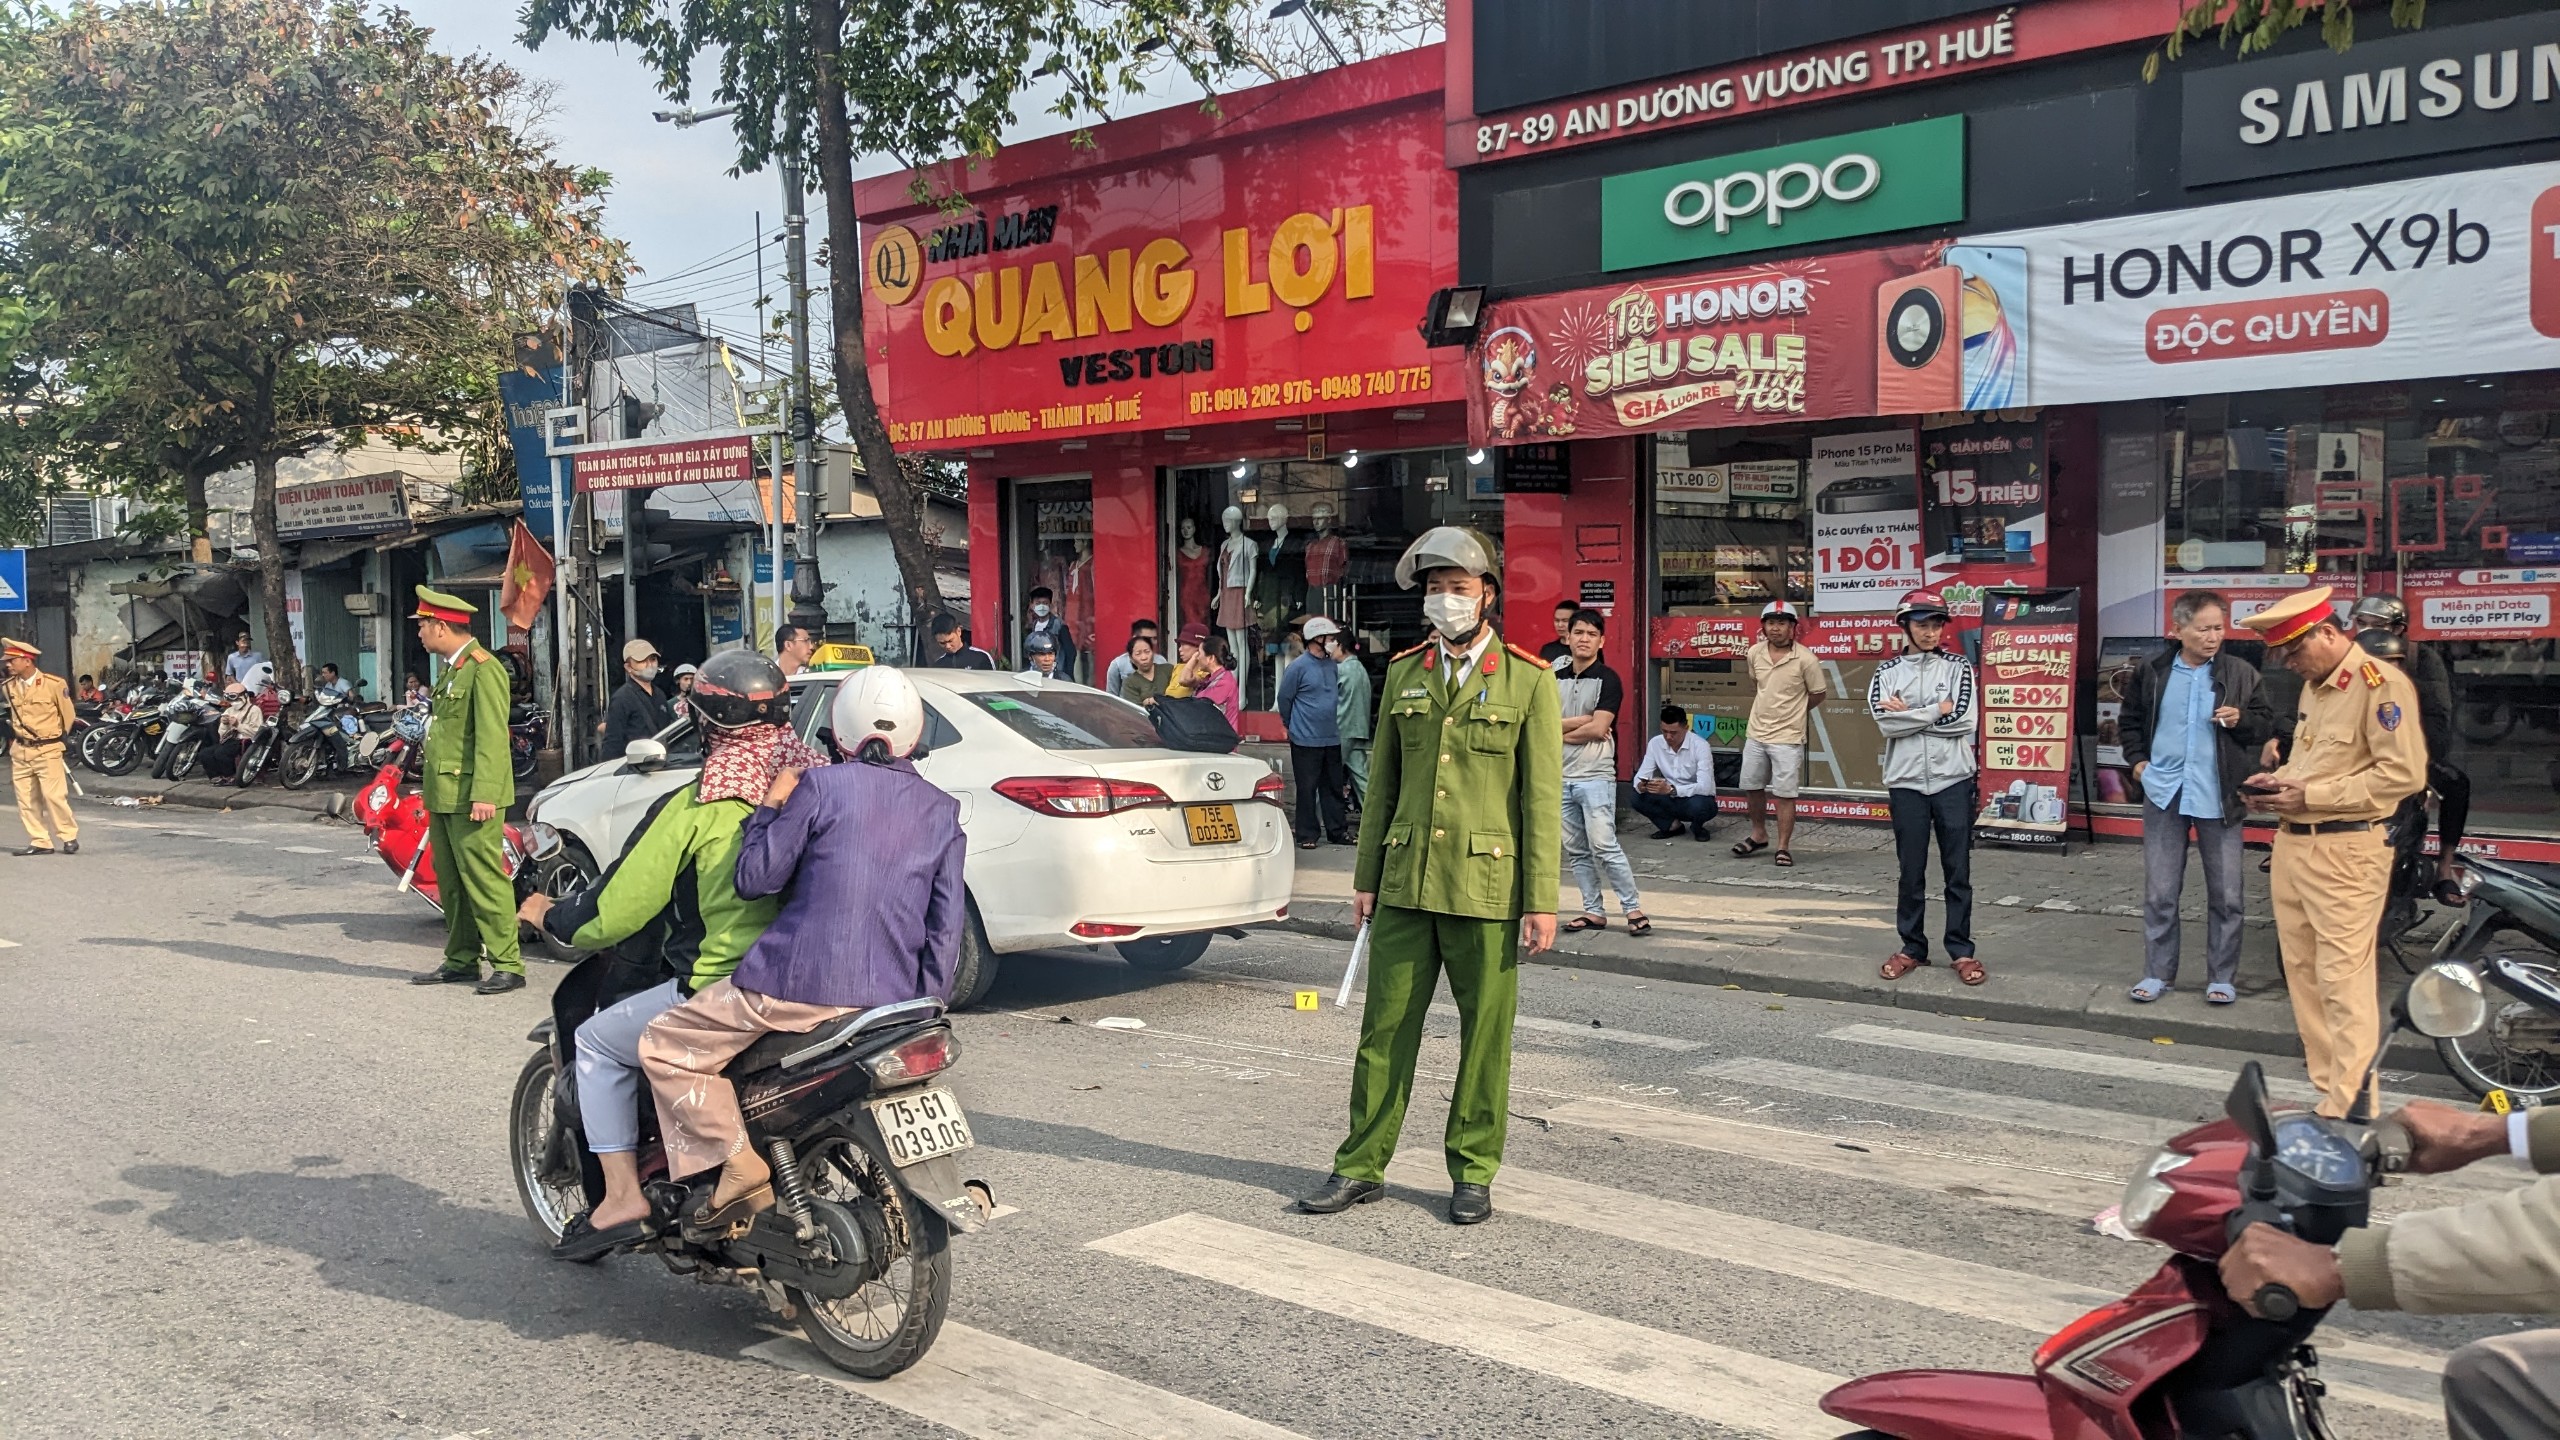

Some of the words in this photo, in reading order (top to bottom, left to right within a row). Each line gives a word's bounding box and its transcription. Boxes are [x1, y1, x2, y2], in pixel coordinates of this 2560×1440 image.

[1476, 114, 1558, 153] 87-89
[1564, 101, 1611, 138] AN
[1617, 77, 1733, 127] DƯƠNG
[1743, 50, 1869, 102] VƯƠNG
[1882, 40, 1932, 76] TP.
[1938, 7, 2017, 65] HUẾ
[1664, 154, 1881, 234] oppo
[2062, 229, 2325, 306] HONOR
[2348, 207, 2491, 277] X9b
[922, 238, 1197, 358] QUANG
[1223, 204, 1375, 333] LỢI
[1608, 292, 1657, 340] Tết
[1665, 278, 1807, 328] HONOR
[2154, 314, 2235, 356] ĐỘC
[2244, 299, 2379, 343] QUYỀN
[1059, 339, 1215, 388] VESTON
[1584, 337, 1680, 396] SIÊU
[1686, 333, 1806, 377] SALE
[1190, 391, 1213, 414] ĐT:
[1214, 387, 1248, 412] 0914
[1251, 384, 1280, 408] 202
[1365, 370, 1395, 396] 740
[1399, 366, 1432, 393] 775
[1735, 364, 1806, 414] Hết
[1623, 384, 1670, 421] GIÁ
[1670, 390, 1699, 409] LUÔN
[1701, 382, 1721, 397] RẺ
[910, 421, 925, 442] 87
[926, 420, 944, 440] AN
[946, 413, 986, 438] DƯƠNG
[990, 409, 1031, 434] VƯƠNG
[1040, 402, 1082, 429] THÀNH
[1086, 394, 1113, 425] PHỐ
[1115, 391, 1143, 423] HUẾ
[1818, 445, 1856, 460] iPhone
[1858, 444, 1872, 457] 15
[1873, 443, 1893, 457] Pro
[1950, 438, 1980, 455] GIẢM
[1983, 436, 2011, 454] ĐẾN
[577, 456, 599, 473] TOÀN
[600, 455, 618, 472] DÂN
[619, 453, 638, 470] TÍCH
[658, 452, 684, 466] THAM
[703, 445, 721, 462] XÂY
[723, 445, 749, 461] DỰNG
[1834, 460, 1850, 469] Màu
[588, 474, 610, 491] CUỘC
[611, 470, 635, 487] SỐNG
[636, 470, 654, 486] VĂN
[655, 466, 673, 483] HÓA
[683, 469, 701, 481] KHU
[703, 464, 723, 479] DÂN
[304, 487, 332, 504] LẠNH
[1931, 470, 1978, 506] 15
[1979, 481, 2041, 507] TRIỆU
[1818, 526, 1838, 538] ĐẶC
[1840, 523, 1874, 536] QUYỀN
[1875, 525, 1885, 534] 12
[1887, 522, 1921, 534] THÁNG
[1818, 549, 1831, 573] 1
[1838, 537, 1907, 573] ĐỔI
[1821, 581, 1839, 590] THU
[1841, 579, 1861, 589] MÁY
[1863, 578, 1876, 588] CŨ
[1878, 577, 1898, 588] ĐẾN
[1900, 578, 1920, 587] 75%
[1994, 603, 2030, 613] FPT
[2441, 600, 2471, 611] Miễn
[2475, 600, 2495, 612] phí
[2499, 600, 2531, 610] Data
[1819, 620, 1834, 629] KHI
[1835, 619, 1853, 628] LÊN
[1854, 619, 1871, 628] ĐỜI
[2431, 615, 2456, 625] truy
[2460, 614, 2484, 625] cập
[2487, 612, 2510, 622] FPT
[2513, 612, 2541, 624] Play
[1713, 622, 1743, 632] APPLE
[1691, 633, 1717, 647] SIÊU
[1718, 635, 1750, 648] SALE
[1829, 633, 1851, 643] GIẢM
[1855, 633, 1887, 654] 1.5
[1992, 631, 2012, 646] Tết
[2015, 634, 2037, 644] GIA
[2039, 633, 2073, 646] DỤNG
[1809, 644, 1832, 654] THÊM
[1833, 643, 1852, 654] ĐẾN
[1985, 647, 2025, 666] SIÊU
[2027, 649, 2071, 665] SALE
[1988, 687, 2010, 695] GIẢM
[2012, 687, 2062, 705] 50%
[1992, 696, 2010, 704] ĐẾN
[1826, 706, 1854, 714] xiaomi
[1697, 720, 1712, 731] VI
[1717, 719, 1736, 731] GIÁ
[1994, 714, 2013, 723] TRẢ
[2016, 715, 2055, 735] 0%
[1993, 724, 2013, 734] GÓP
[1996, 744, 2014, 754] CHỈ
[2016, 745, 2052, 768] 9K
[1999, 756, 2014, 765] TỪ
[1729, 800, 1747, 811] DỤN
[1822, 804, 1847, 815] GIẢM
[1849, 803, 1870, 816] ĐẾN
[1201, 807, 1224, 823] 75E
[1196, 823, 1236, 840] 003.35
[2011, 833, 2032, 841] 1800
[2033, 834, 2057, 842] 6601
[1302, 994, 1310, 1006] 7
[2496, 1094, 2504, 1109] 6
[885, 1092, 947, 1128] 75-G1
[891, 1120, 966, 1159] 039.06
